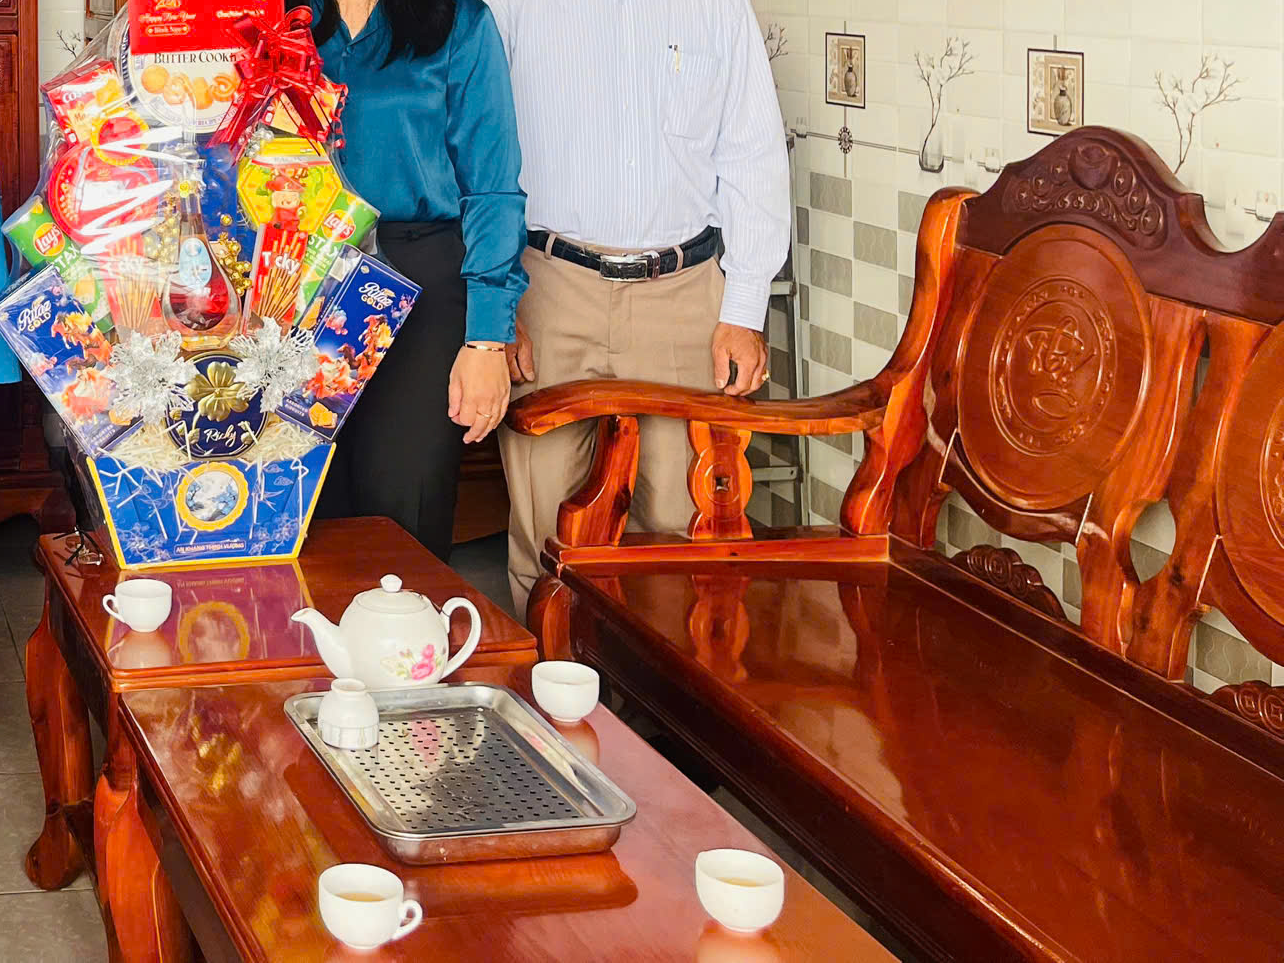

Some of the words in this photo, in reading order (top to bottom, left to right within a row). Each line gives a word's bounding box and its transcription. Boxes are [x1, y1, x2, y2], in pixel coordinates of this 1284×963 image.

[154, 52, 196, 64] BUTTER
[262, 252, 300, 275] Tcky
[361, 294, 384, 310] GOLD
[28, 311, 52, 332] GOLD
